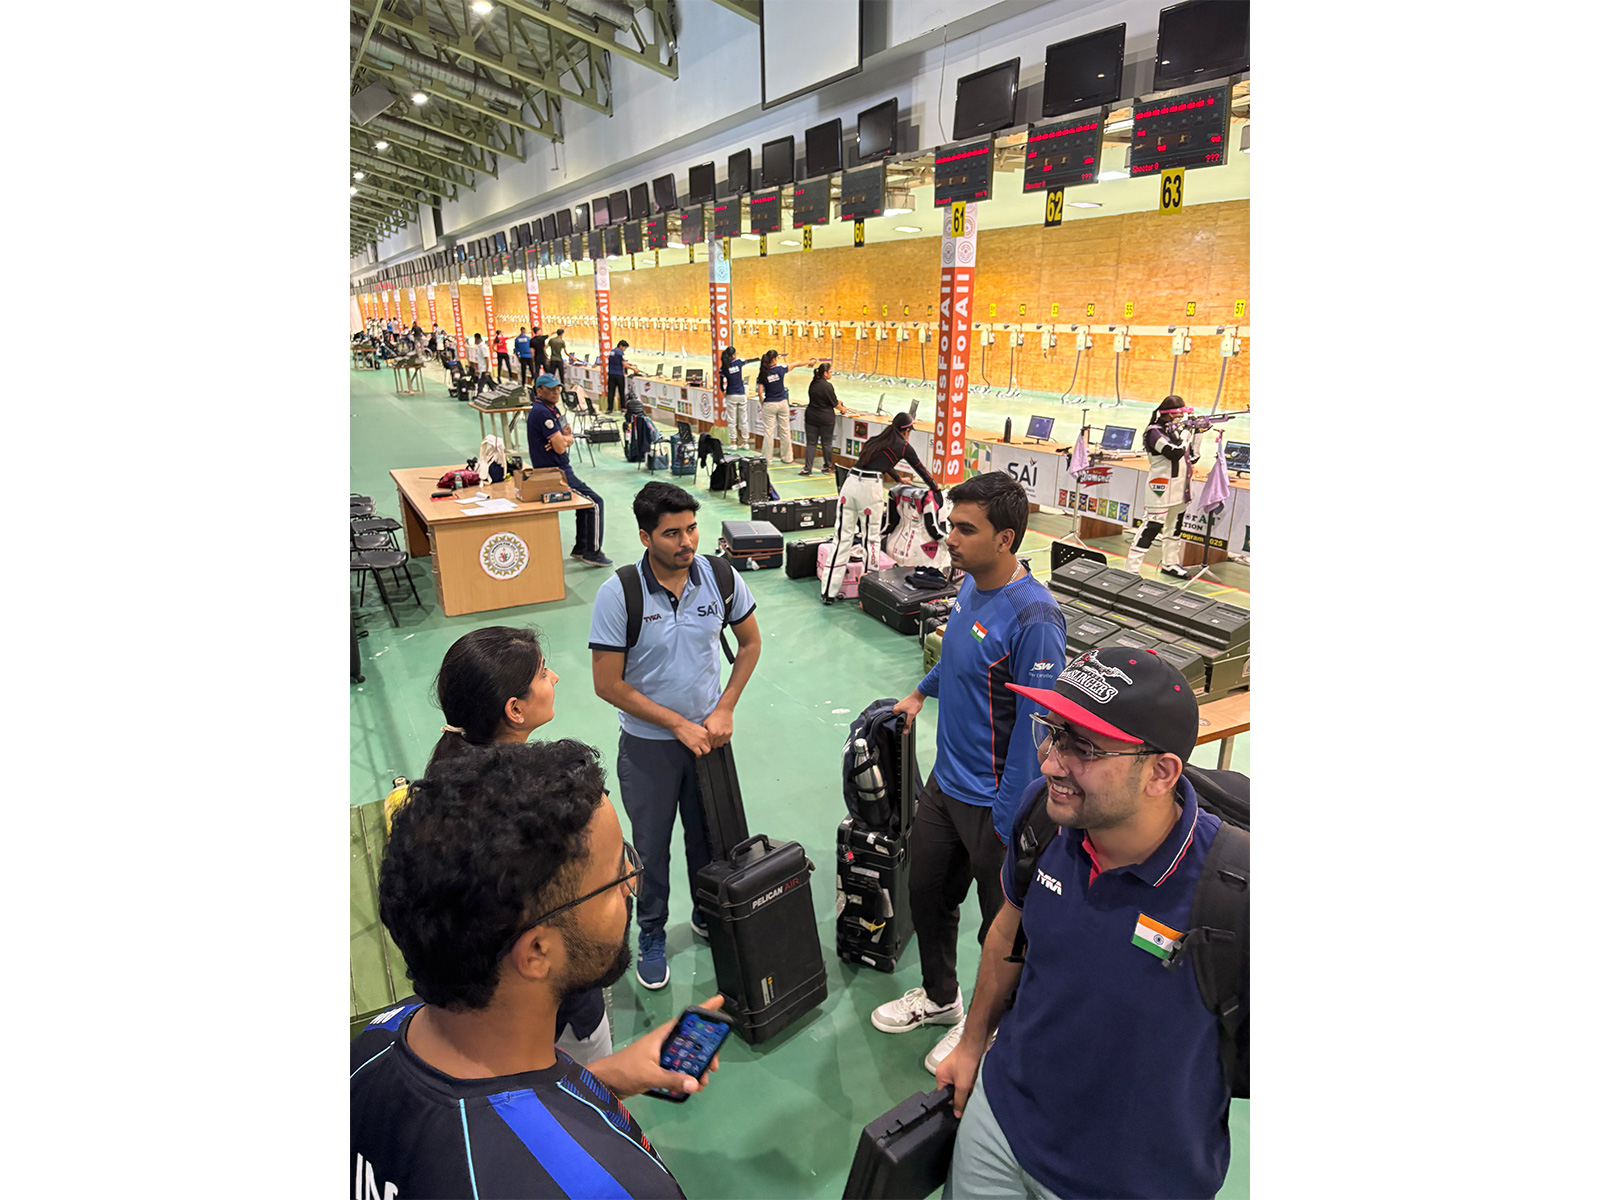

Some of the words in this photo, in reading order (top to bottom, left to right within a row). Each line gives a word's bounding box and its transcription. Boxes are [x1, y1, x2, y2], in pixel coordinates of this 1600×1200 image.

[1162, 174, 1182, 209] 63
[953, 207, 964, 232] 61
[1047, 191, 1063, 222] 62
[1235, 302, 1244, 314] 57
[933, 273, 952, 475] SportsForAll
[947, 273, 970, 476] SportsForAll
[1007, 461, 1038, 487] SAI
[1209, 538, 1223, 547] 025
[697, 604, 718, 617] SAI
[752, 886, 783, 909] PELICAN
[784, 877, 799, 891] AIR
[1036, 868, 1062, 896] TYKA
[355, 1152, 399, 1200] IN
